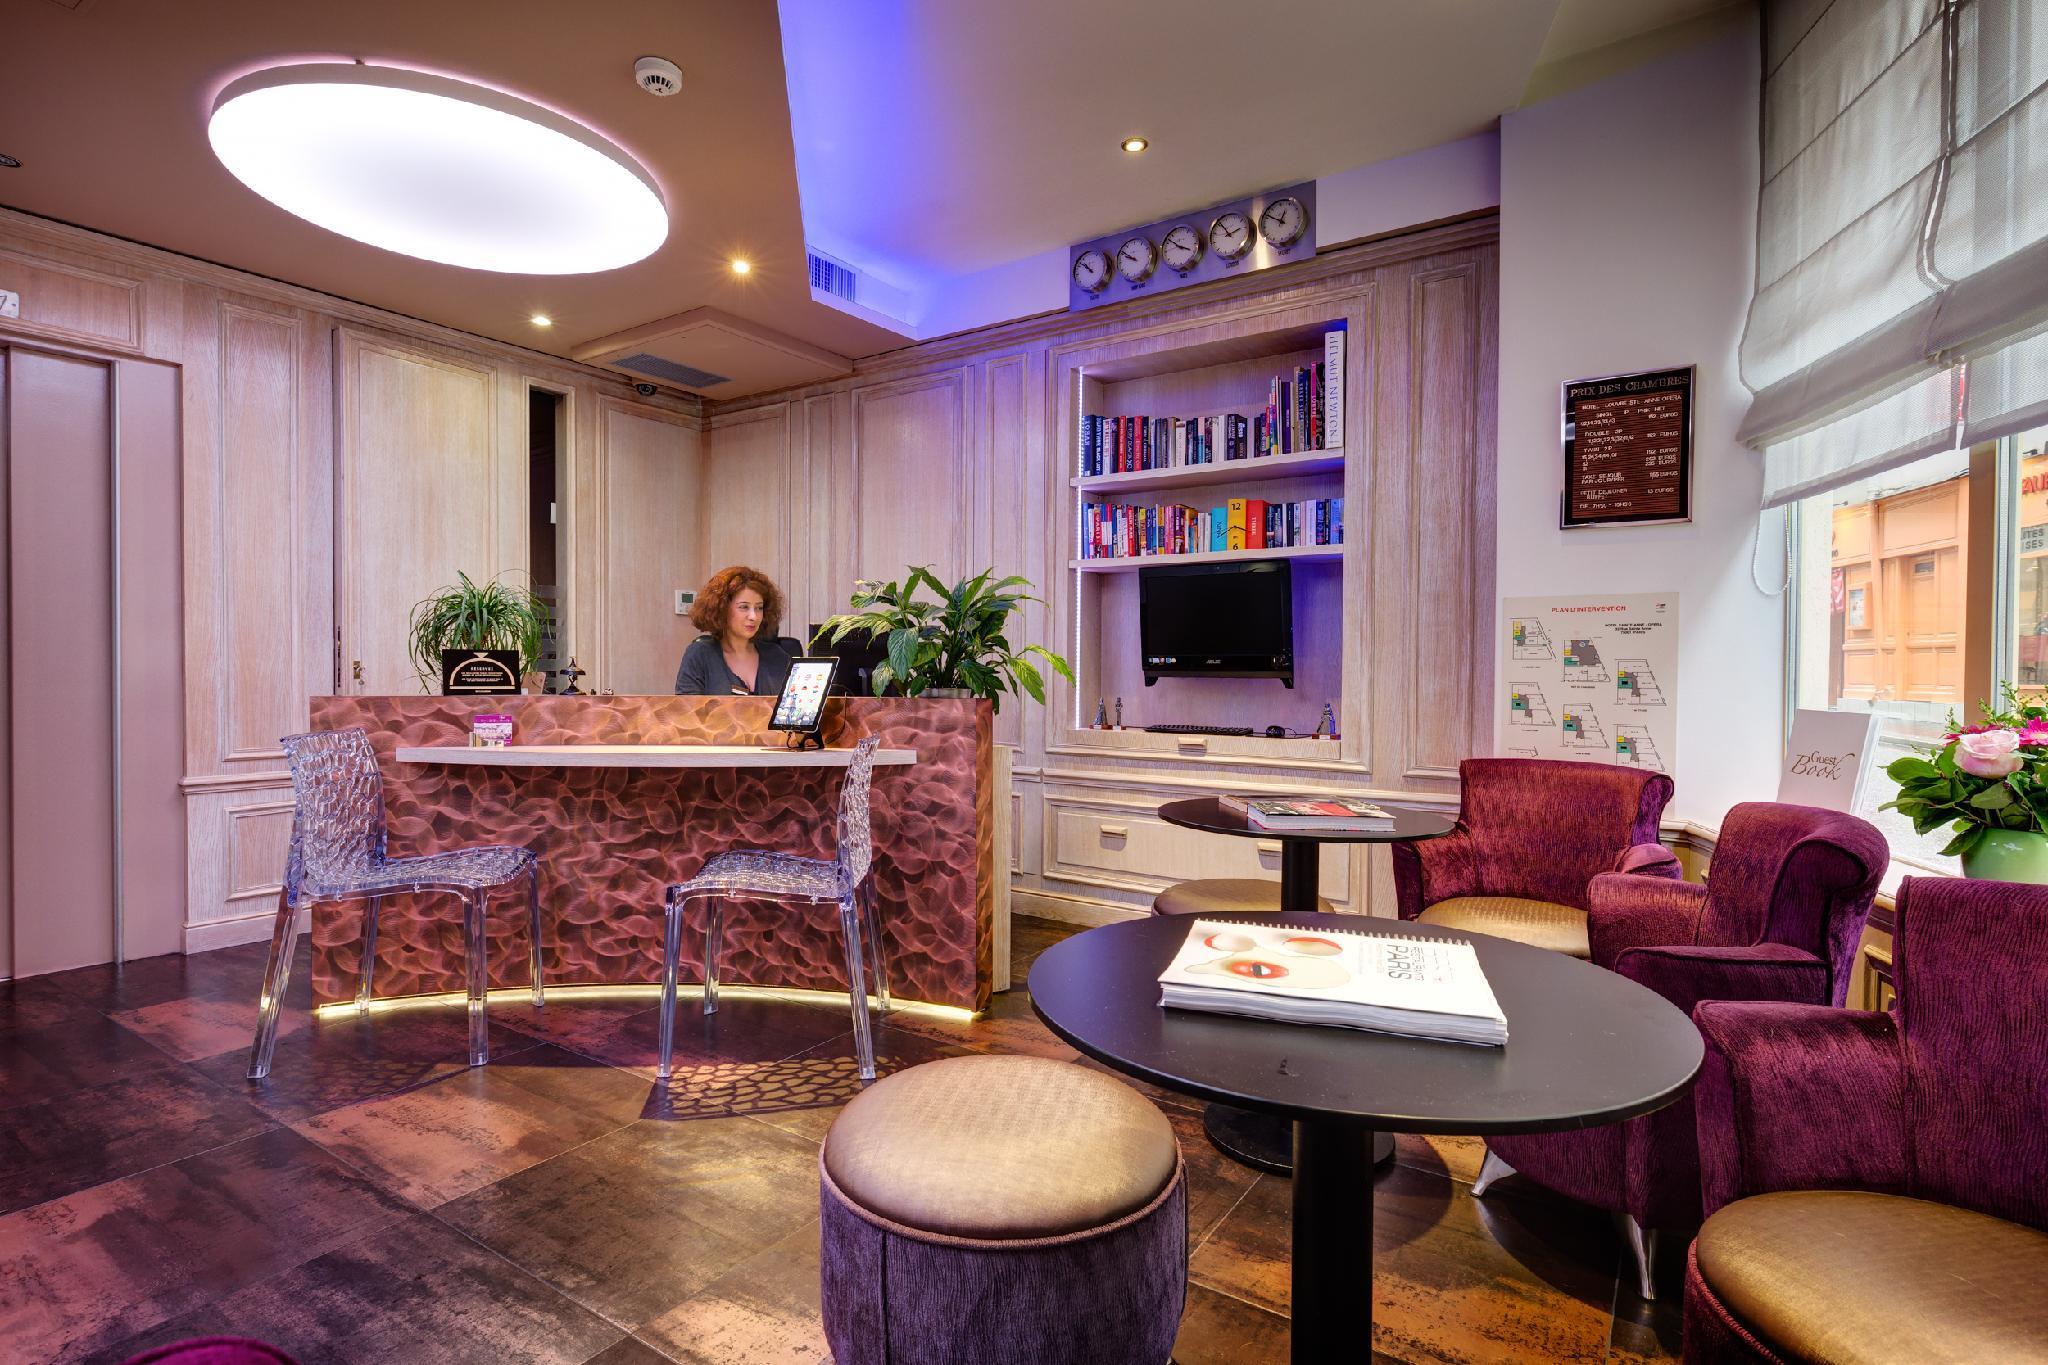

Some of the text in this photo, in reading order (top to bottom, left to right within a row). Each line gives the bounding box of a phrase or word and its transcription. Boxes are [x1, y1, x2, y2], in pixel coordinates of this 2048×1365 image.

[1570, 375, 1689, 397] PRIX DES CHAMBRES
[1329, 386, 1339, 437] NEWTON
[1231, 502, 1241, 511] 12
[1791, 752, 1856, 780] Book
[1811, 750, 1837, 766] Guest
[1386, 944, 1412, 980] PARIS
